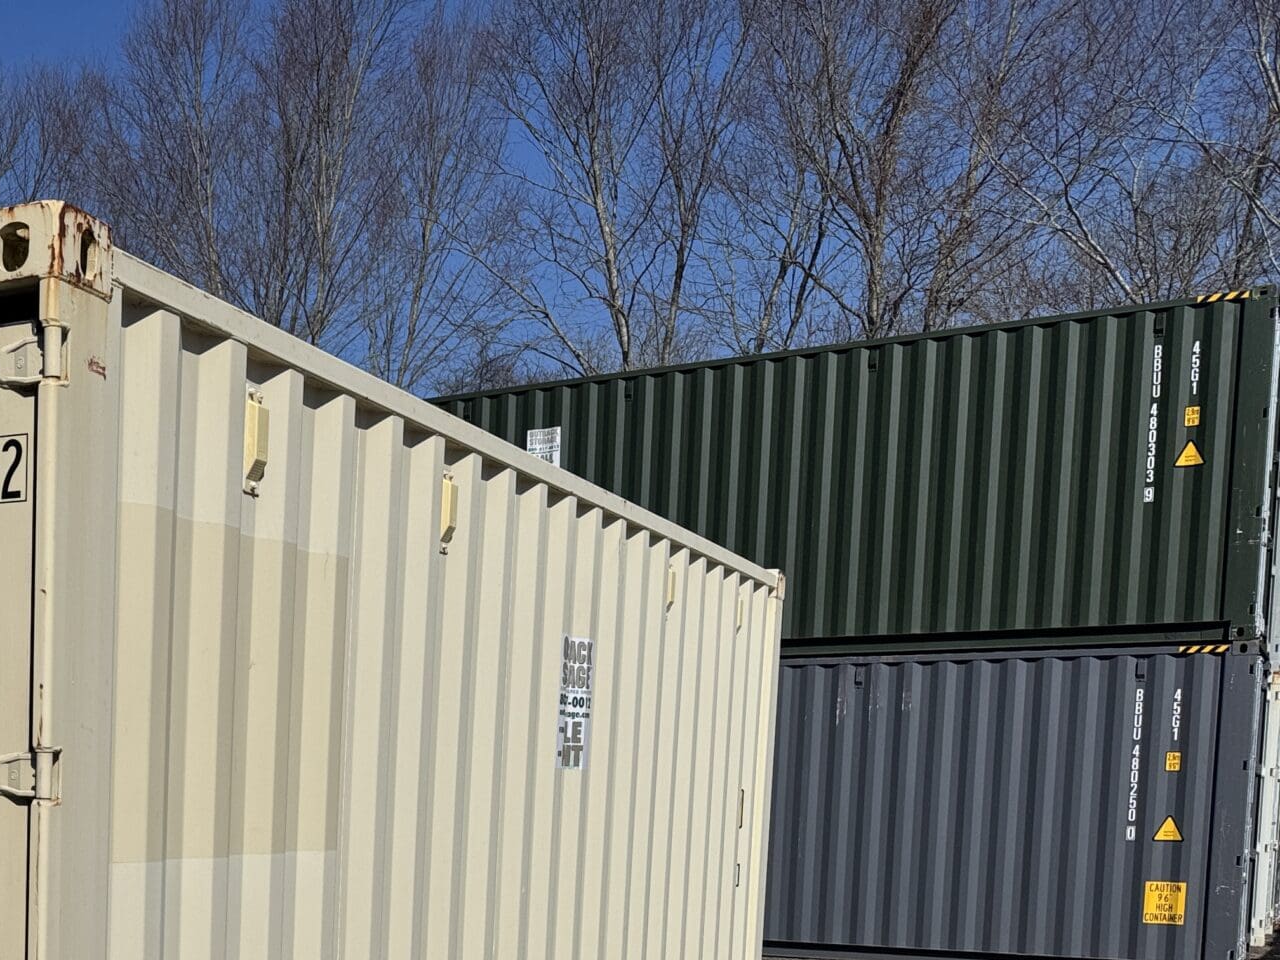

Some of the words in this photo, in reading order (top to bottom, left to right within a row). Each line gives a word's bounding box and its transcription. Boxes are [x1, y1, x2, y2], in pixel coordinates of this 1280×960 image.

[1152, 345, 1162, 398] BBUU
[1190, 340, 1200, 394] 45G1
[1146, 403, 1158, 483] 480303
[1, 438, 23, 500] 2
[1144, 487, 1153, 501] 9
[1133, 689, 1144, 740] BBUU
[1172, 689, 1181, 740] 45G1
[1127, 745, 1140, 821] 480250
[1150, 883, 1182, 893] CAUTION
[1156, 903, 1173, 912] HIGH
[1144, 912, 1183, 923] CONTAINER
